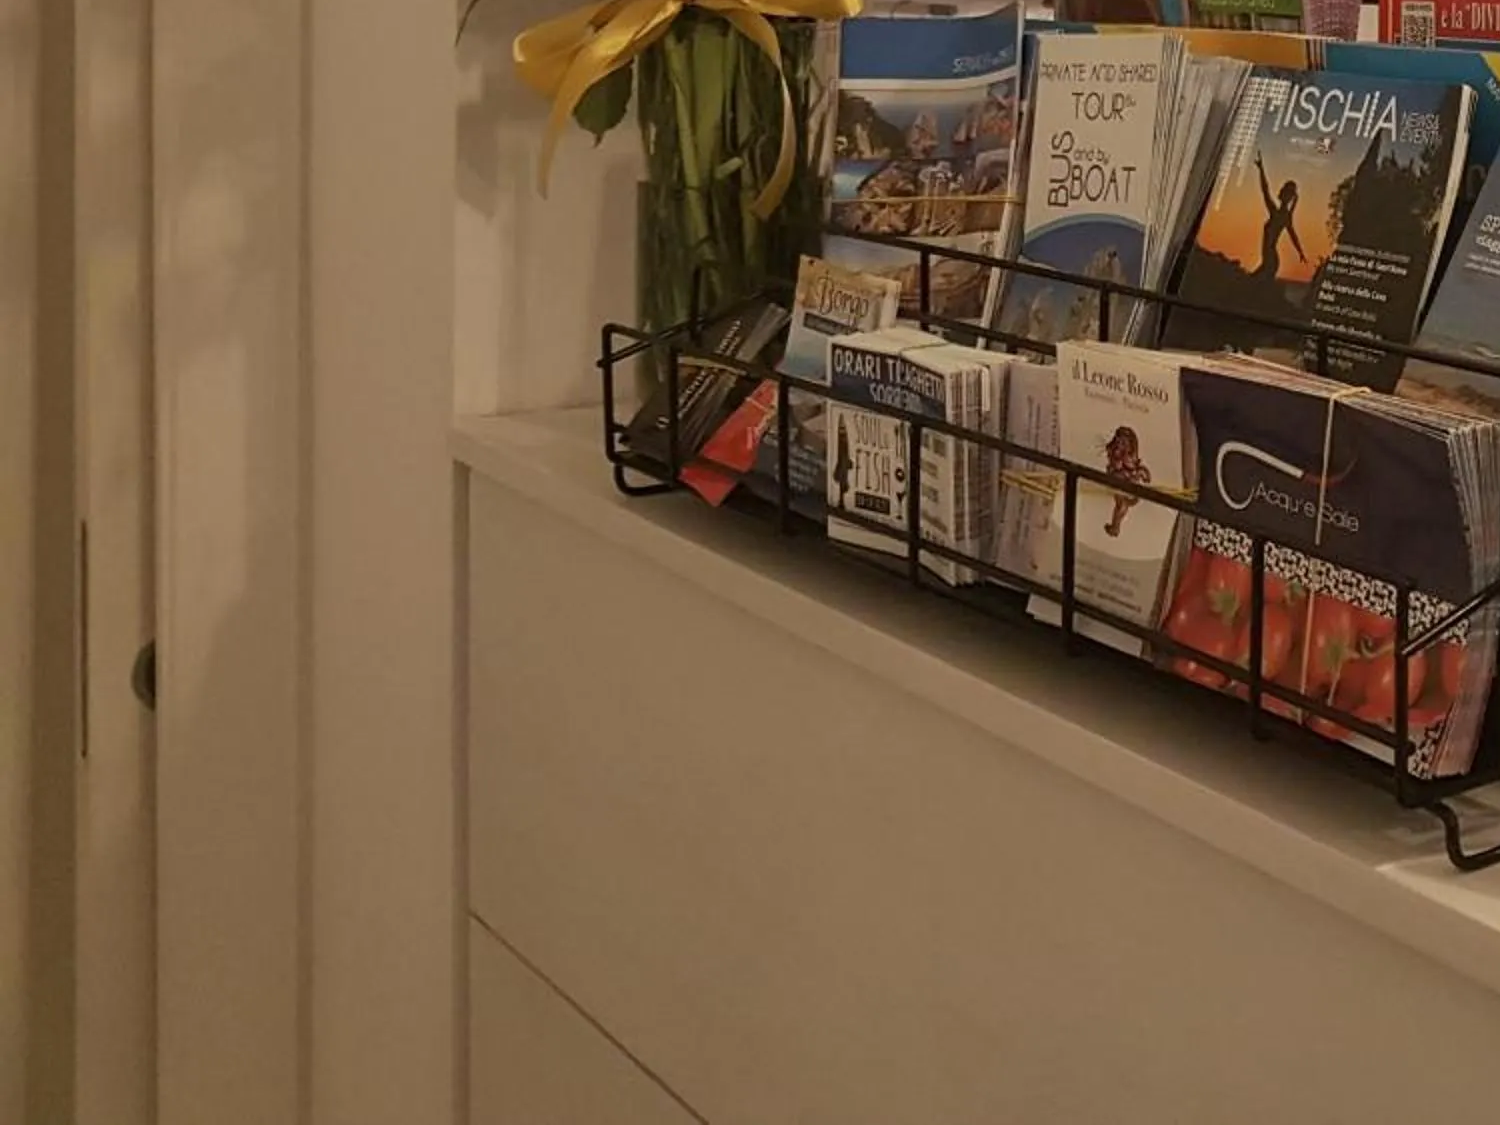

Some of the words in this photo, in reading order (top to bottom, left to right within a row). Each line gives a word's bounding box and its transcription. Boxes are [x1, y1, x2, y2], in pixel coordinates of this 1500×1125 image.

[1451, 3, 1463, 27] la
[1072, 92, 1124, 122] TOUR
[1048, 130, 1075, 207] BUS
[1069, 164, 1137, 203] BOAT
[833, 348, 881, 380] ORARI
[1127, 372, 1169, 403] Rosso
